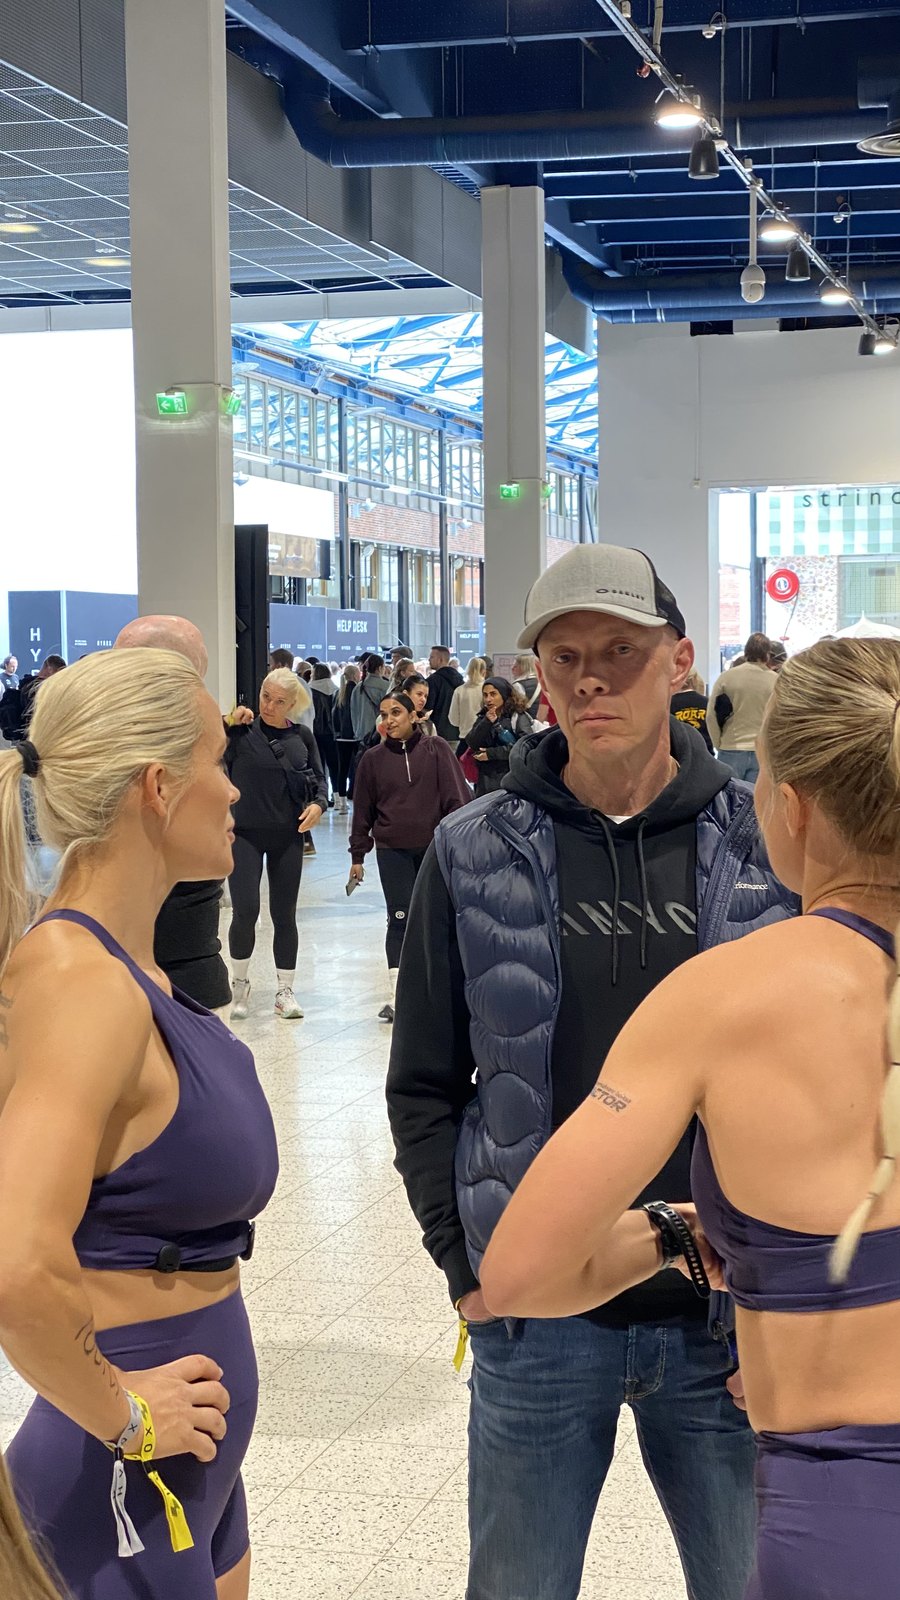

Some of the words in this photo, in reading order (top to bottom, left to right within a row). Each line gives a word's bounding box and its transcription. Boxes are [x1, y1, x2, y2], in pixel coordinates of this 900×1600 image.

[336, 619, 351, 632] HELP
[352, 620, 368, 633] DESK
[675, 709, 706, 721] ROAR
